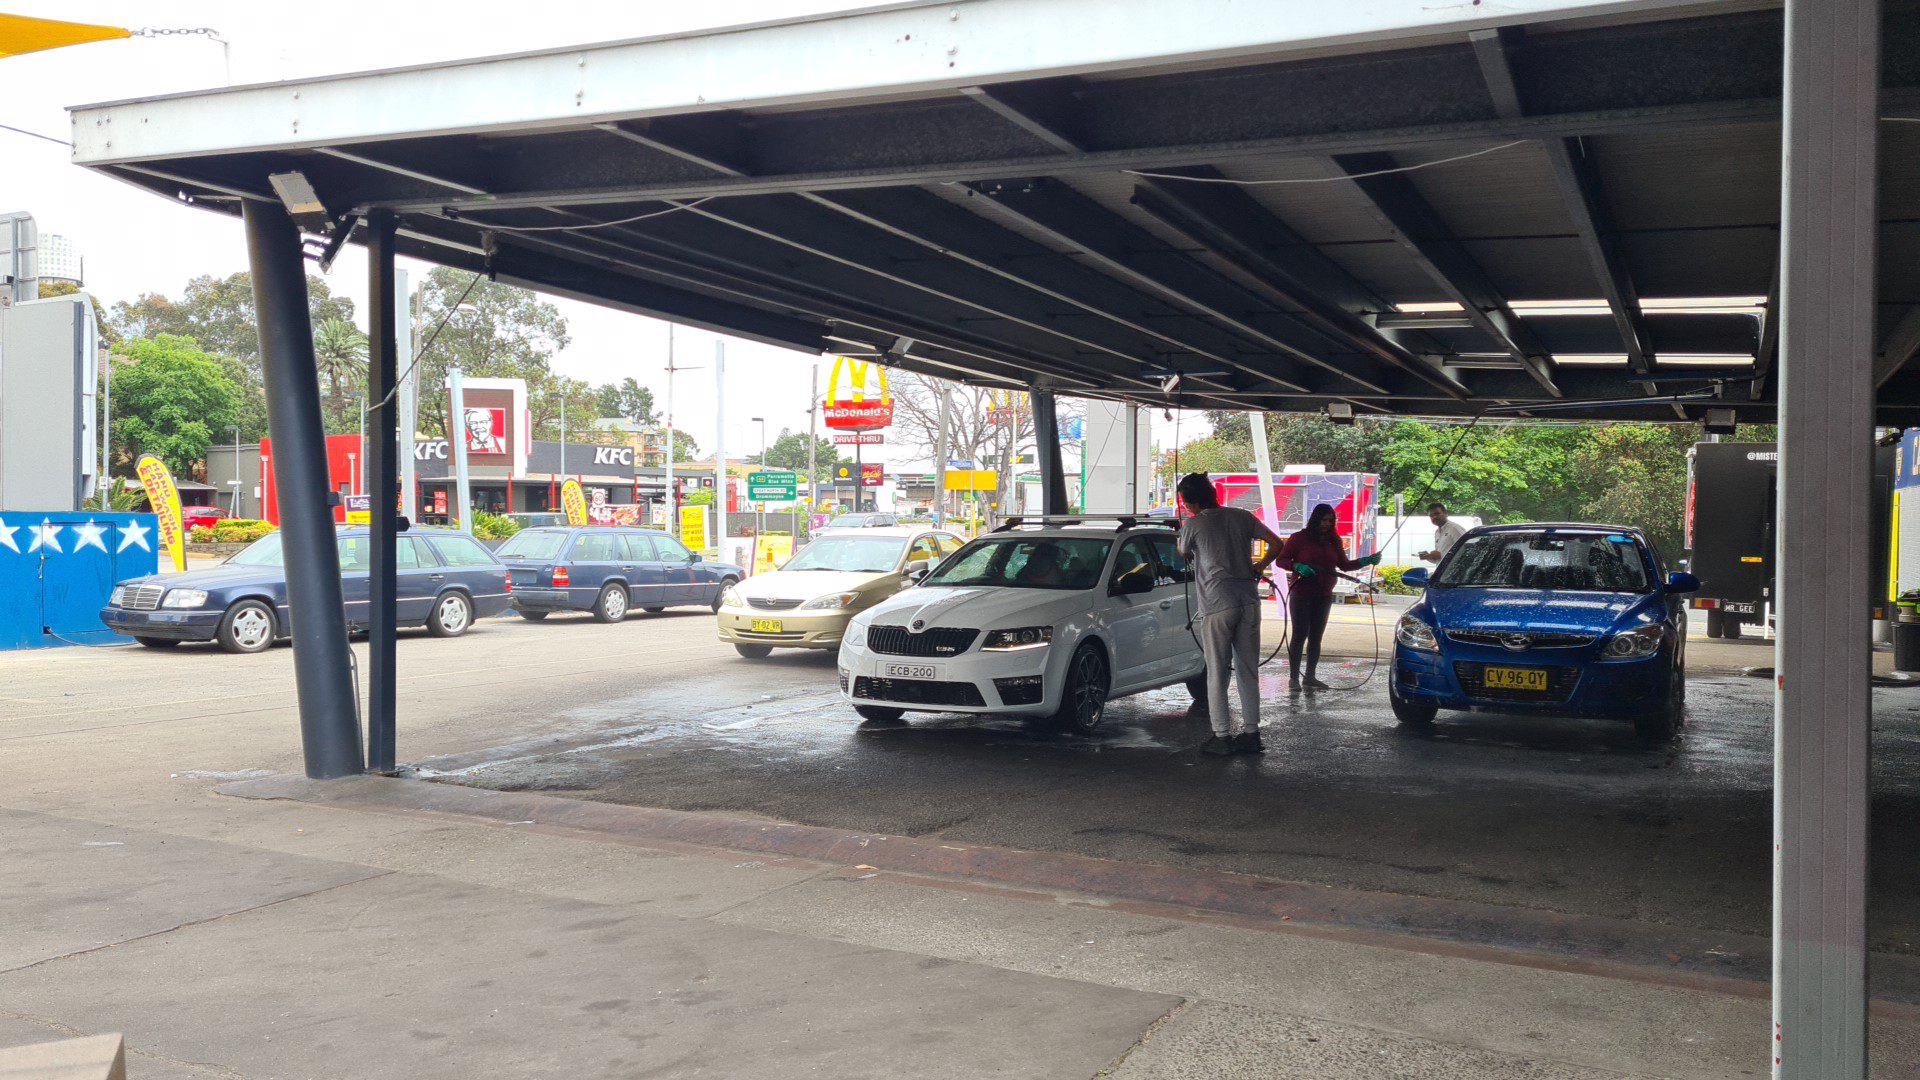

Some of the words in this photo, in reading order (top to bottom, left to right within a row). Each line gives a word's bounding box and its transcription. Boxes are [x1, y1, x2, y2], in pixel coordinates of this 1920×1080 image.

[825, 408, 891, 418] McDonald's
[834, 435, 857, 443] DRIVE
[859, 435, 880, 443] THRU
[414, 441, 448, 460] KFC
[594, 447, 632, 466] KFC
[145, 479, 176, 545] DETAILING
